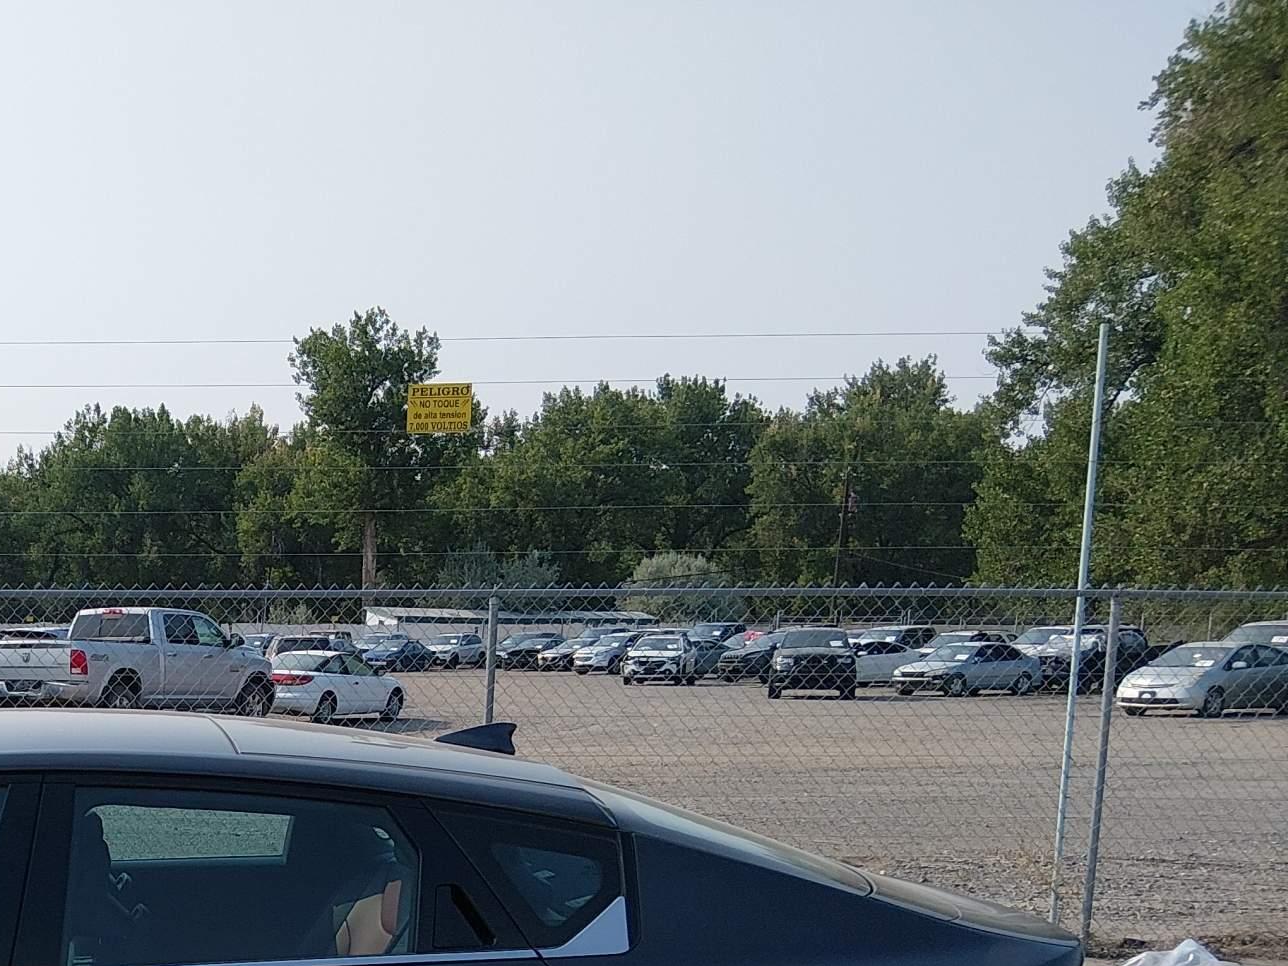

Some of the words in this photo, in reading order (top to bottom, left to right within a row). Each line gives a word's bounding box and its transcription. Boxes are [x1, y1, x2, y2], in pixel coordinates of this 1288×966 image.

[412, 386, 469, 396] PELIGRO
[419, 400, 430, 408] NO
[432, 399, 460, 408] TOQUE
[413, 411, 422, 419] de
[424, 411, 438, 419] alta
[431, 421, 468, 430] VOLTIOS
